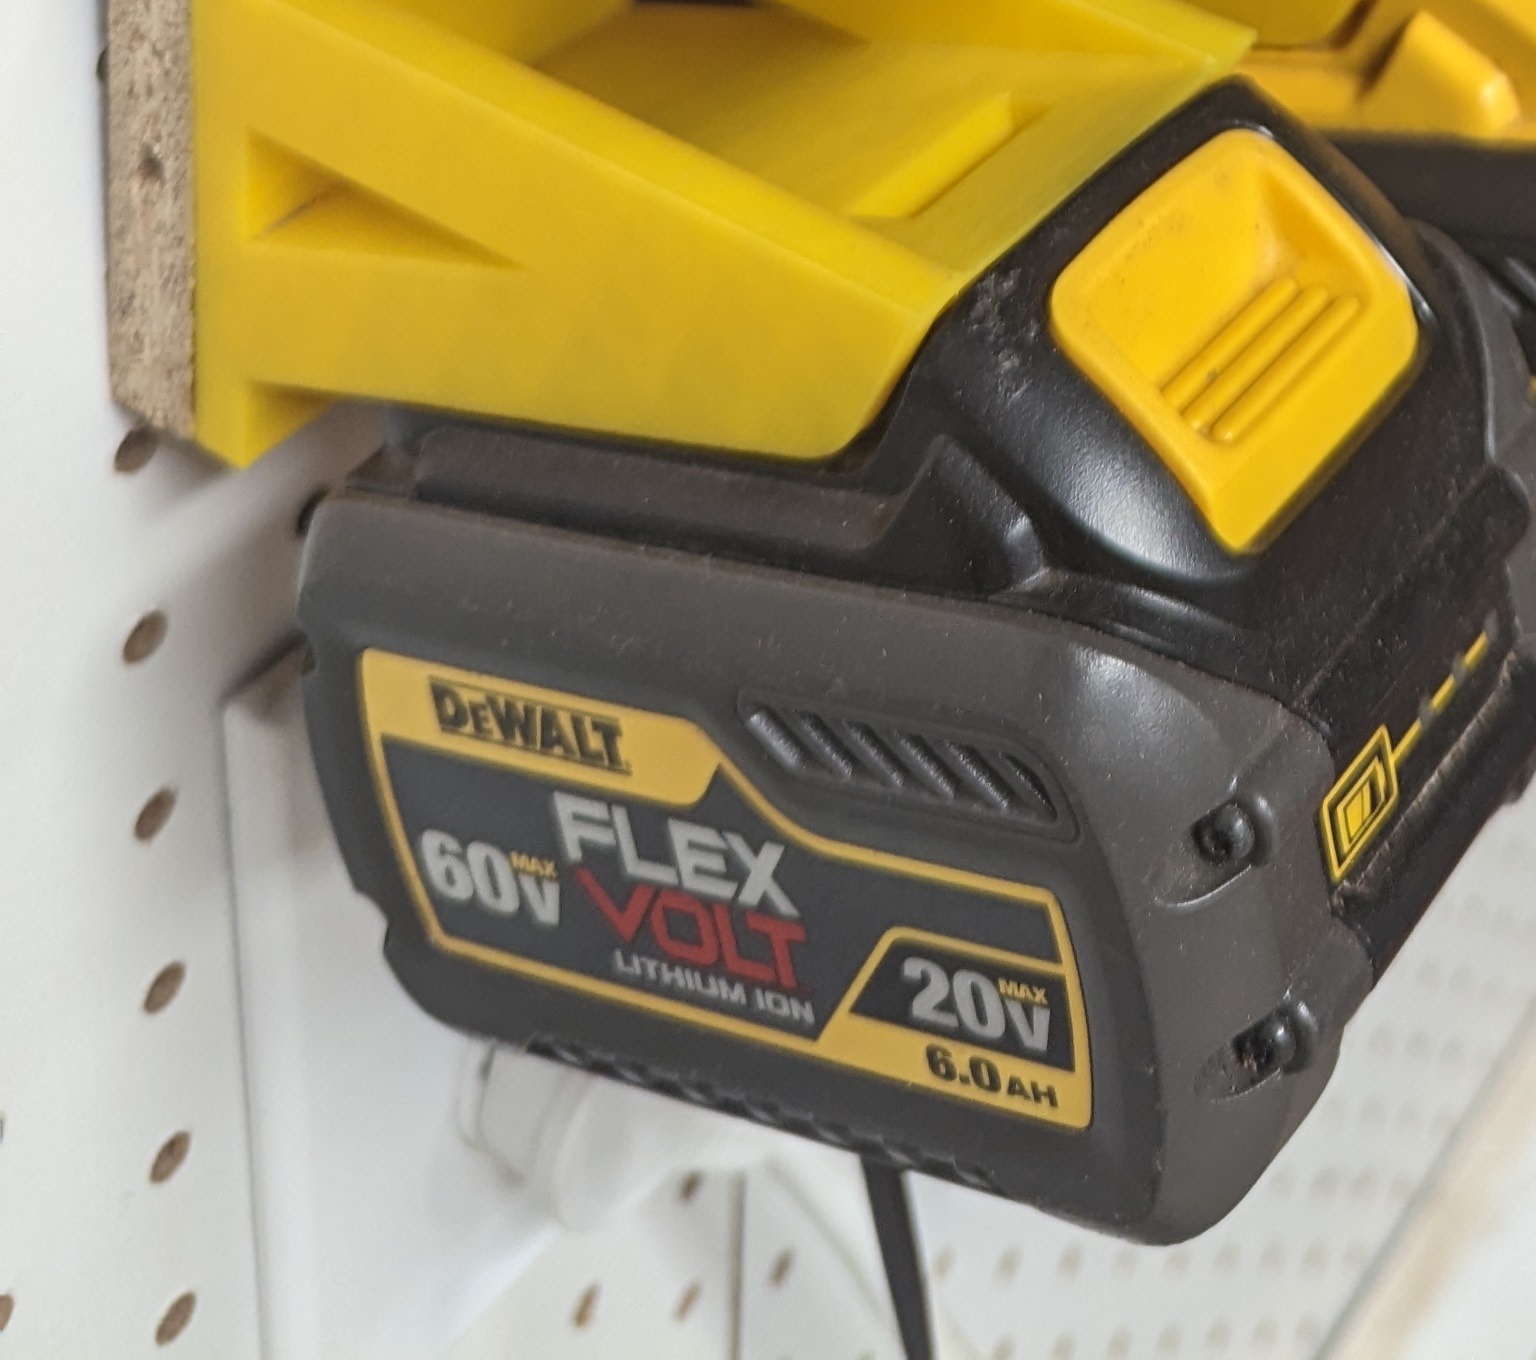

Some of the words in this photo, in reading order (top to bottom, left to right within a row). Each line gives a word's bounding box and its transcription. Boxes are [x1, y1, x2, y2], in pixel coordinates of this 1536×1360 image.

[508, 849, 559, 881] MAX
[552, 790, 800, 918] FLEX
[575, 865, 806, 989] VOLT
[612, 947, 748, 1006] LITHIUM
[753, 987, 816, 1026] ION
[997, 976, 1050, 1007] MAX
